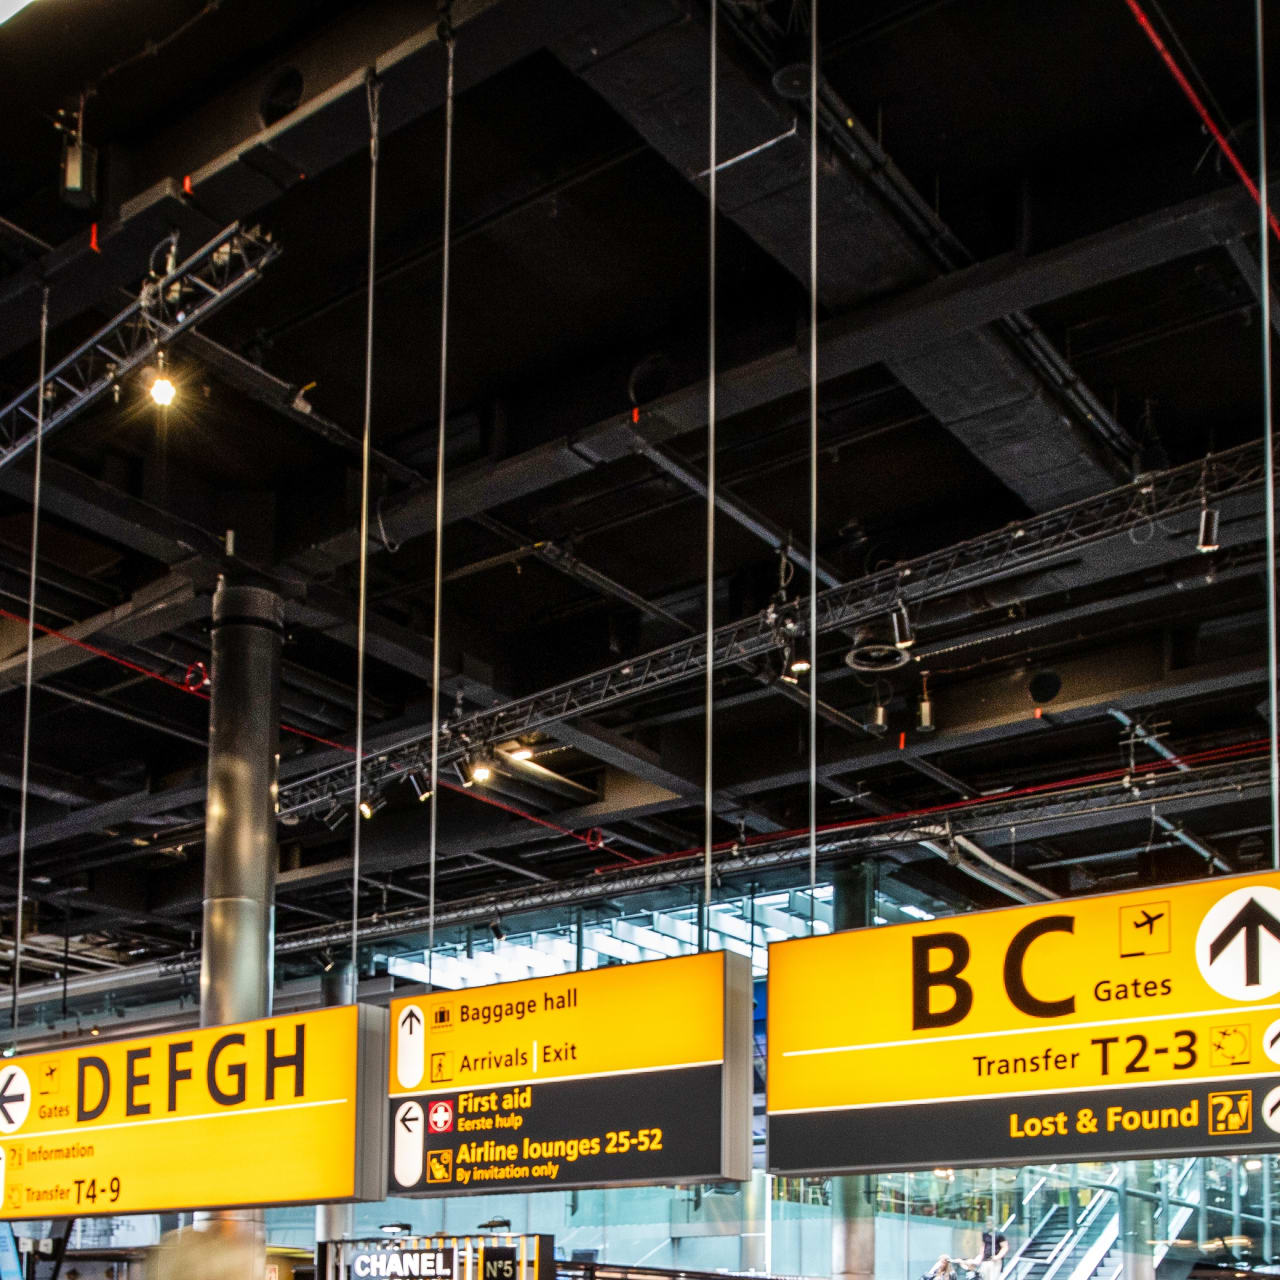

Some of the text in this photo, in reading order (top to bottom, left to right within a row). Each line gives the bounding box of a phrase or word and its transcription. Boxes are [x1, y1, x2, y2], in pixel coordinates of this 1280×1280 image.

[1094, 977, 1172, 1003] Gates
[460, 988, 578, 1025] Baggage hall
[459, 1042, 578, 1073] Arrivals Exit
[973, 1030, 1197, 1077] Transfer T2-3
[38, 1103, 70, 1120] Gates
[457, 1086, 532, 1115] First aid
[457, 1114, 523, 1132] Eerste hulp
[1009, 1100, 1199, 1139] Lost & Found
[26, 1143, 95, 1162] Information
[455, 1128, 663, 1165] Airline lounges 25-52
[455, 1161, 560, 1185] By invitation only
[25, 1177, 122, 1206] Transfer T4-9
[353, 1252, 451, 1278] CHANEL
